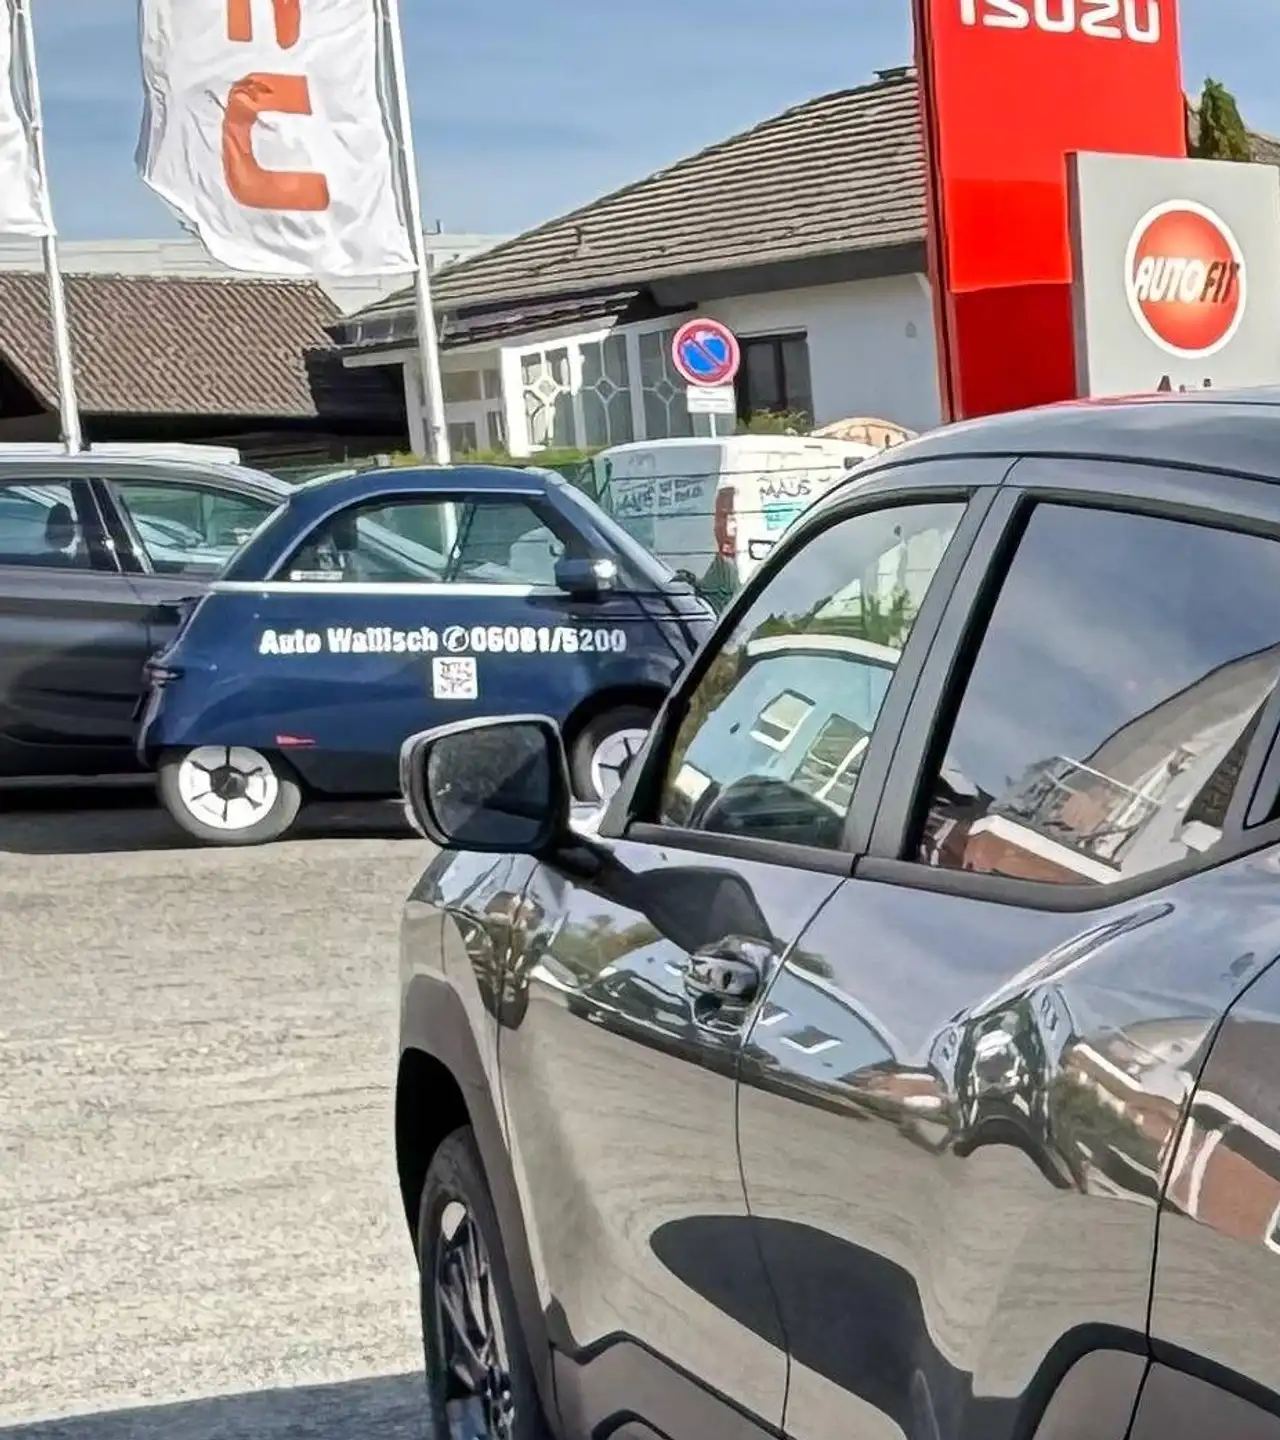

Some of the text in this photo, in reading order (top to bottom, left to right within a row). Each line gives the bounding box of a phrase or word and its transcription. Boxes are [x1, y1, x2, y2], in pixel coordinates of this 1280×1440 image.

[960, 0, 1160, 44] ISUZU
[259, 626, 627, 654] Auto Wallisch 06081/5200
